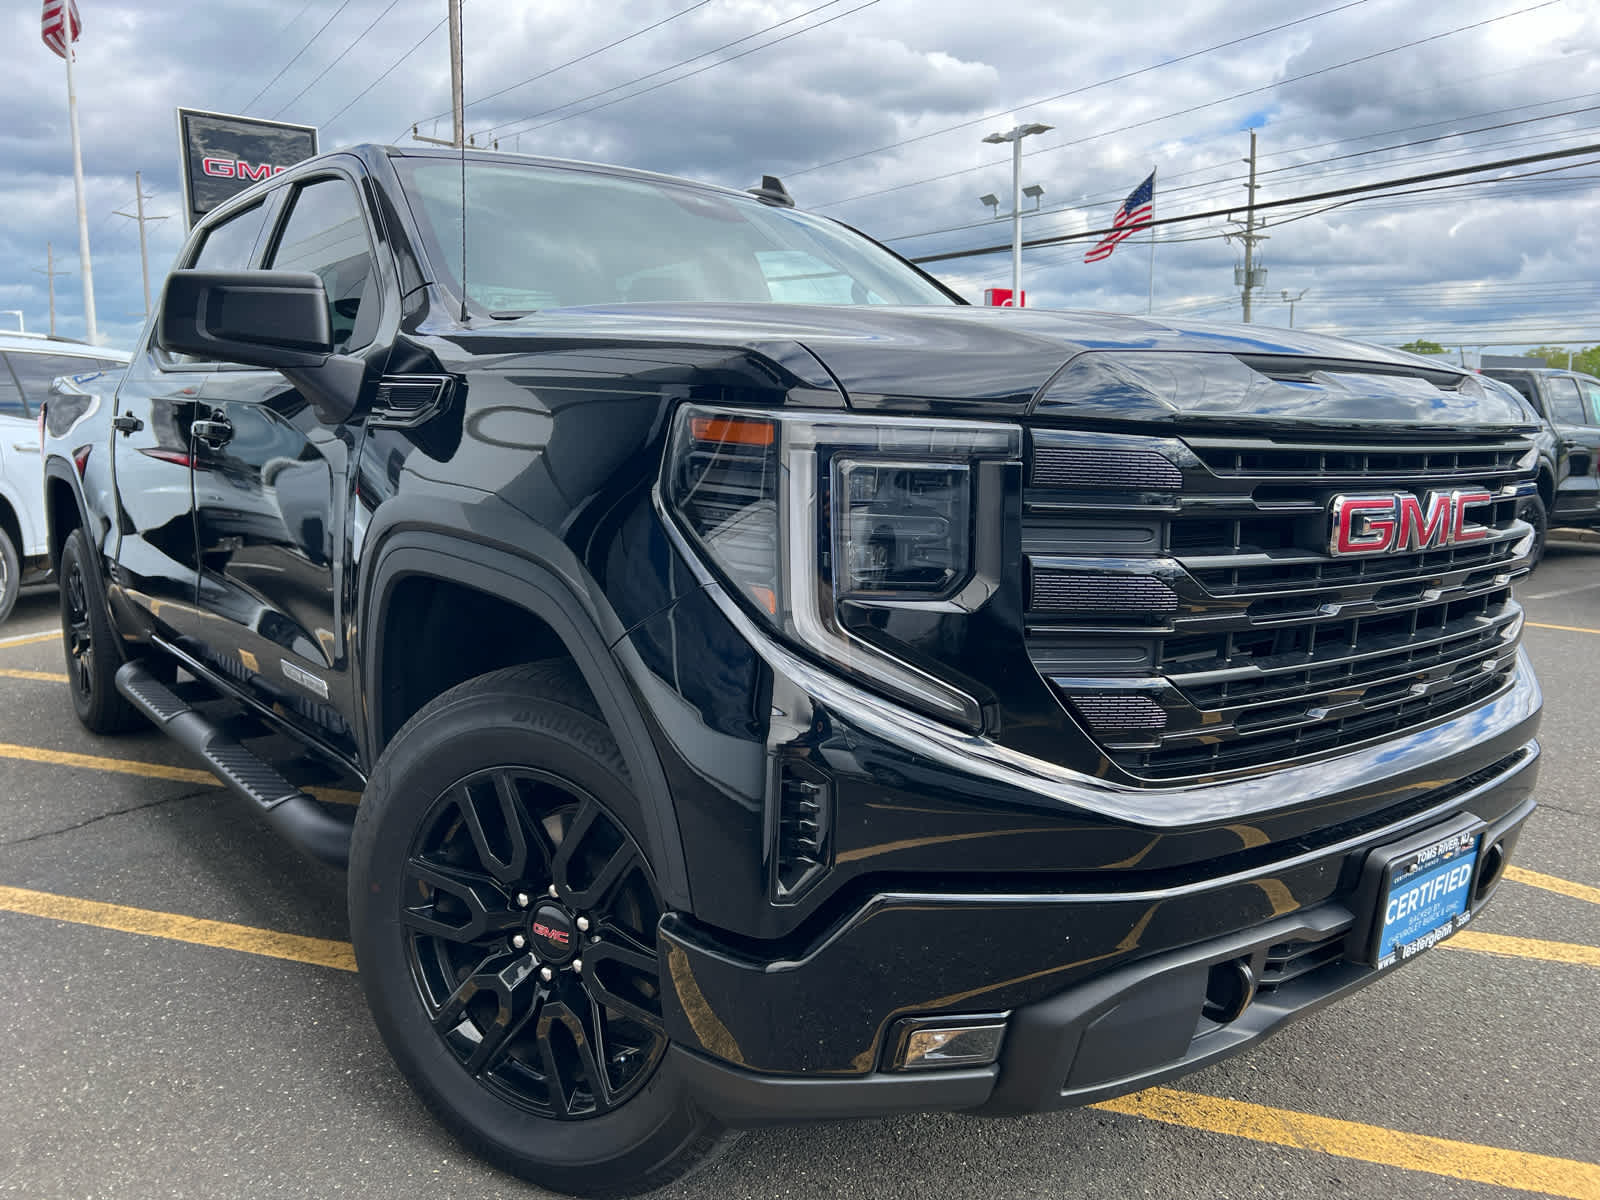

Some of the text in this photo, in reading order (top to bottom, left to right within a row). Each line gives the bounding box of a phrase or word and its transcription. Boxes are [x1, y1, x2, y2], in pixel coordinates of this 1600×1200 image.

[1331, 491, 1491, 557] GMC
[1418, 847, 1437, 865] TOMS
[1385, 863, 1472, 925] CERTIFIED
[532, 922, 569, 944] GMC
